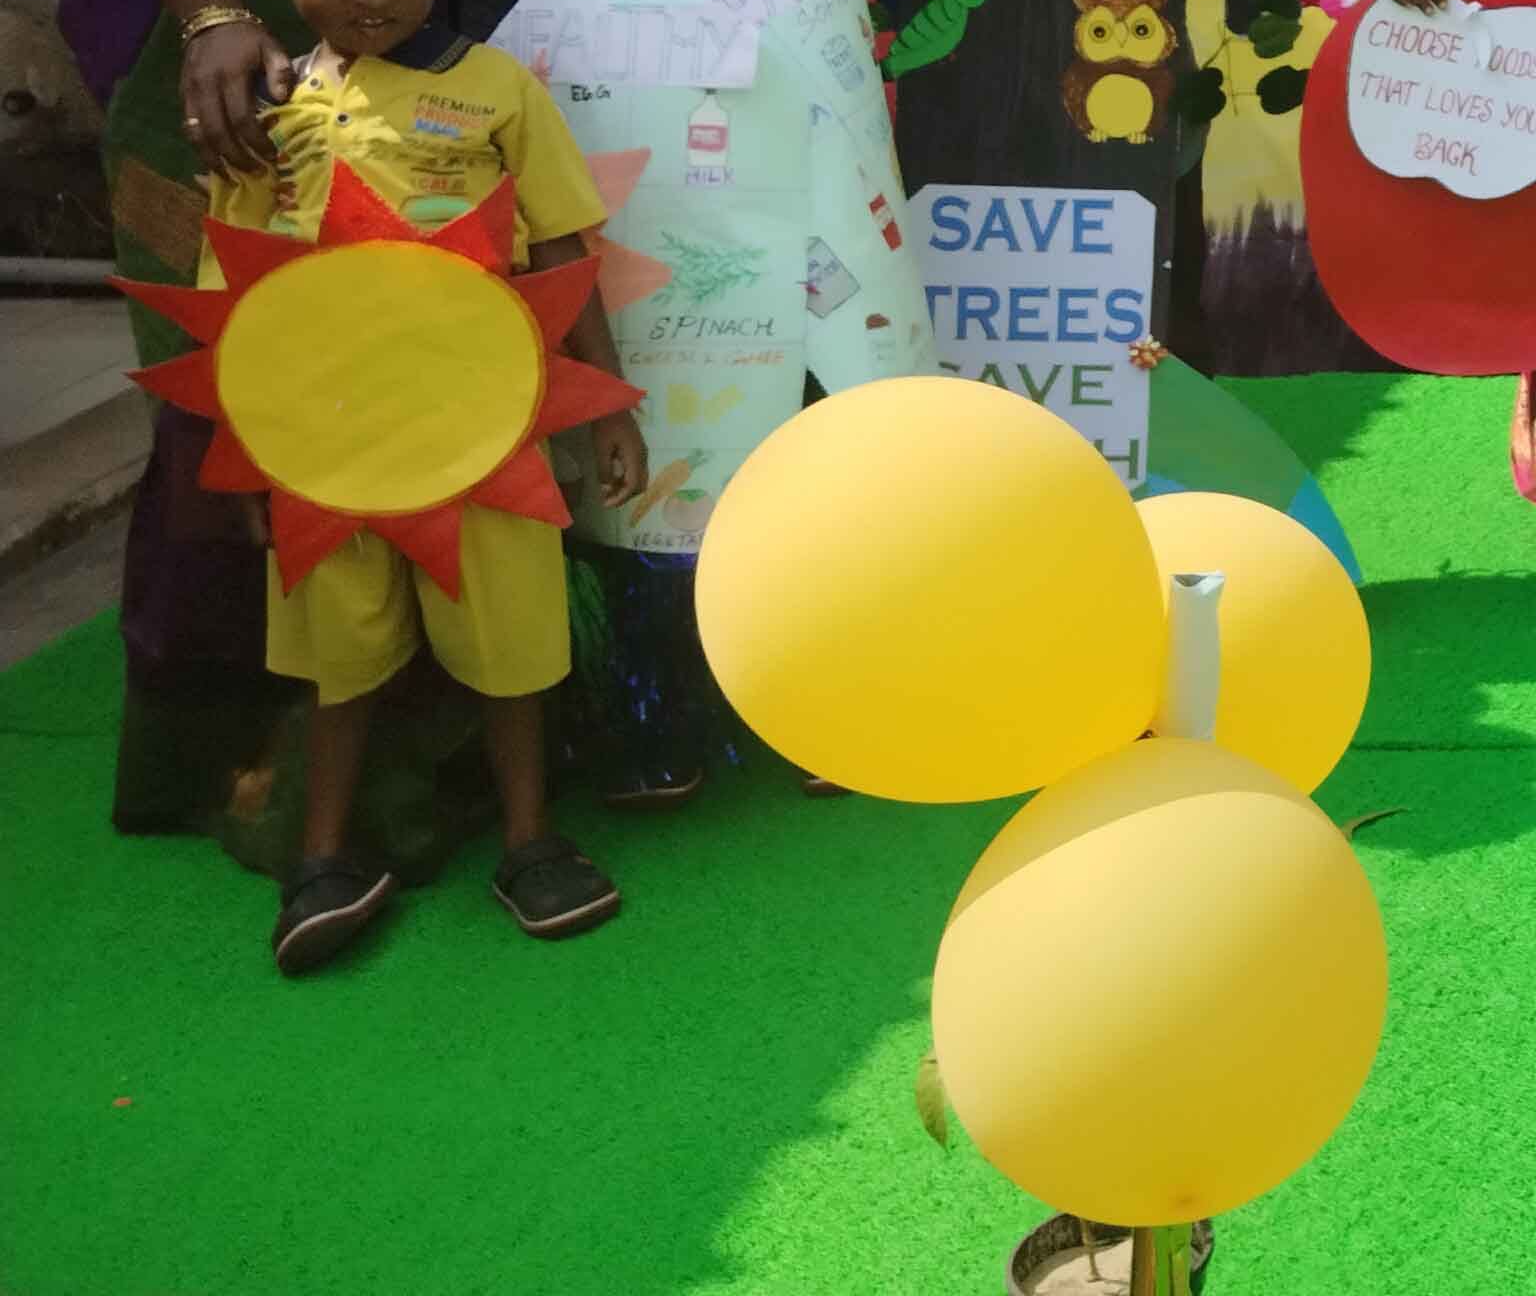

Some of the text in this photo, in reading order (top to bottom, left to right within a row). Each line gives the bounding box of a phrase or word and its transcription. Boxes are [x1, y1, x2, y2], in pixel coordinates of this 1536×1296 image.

[1368, 20, 1465, 64] CHOOSE
[417, 93, 497, 117] PREMIUM
[1360, 71, 1421, 105] THAT
[1424, 86, 1494, 123] LOVES
[685, 167, 734, 185] MILK
[928, 195, 1115, 255] SAVE
[649, 316, 776, 341] SPINACH
[923, 284, 1145, 344] TREES
